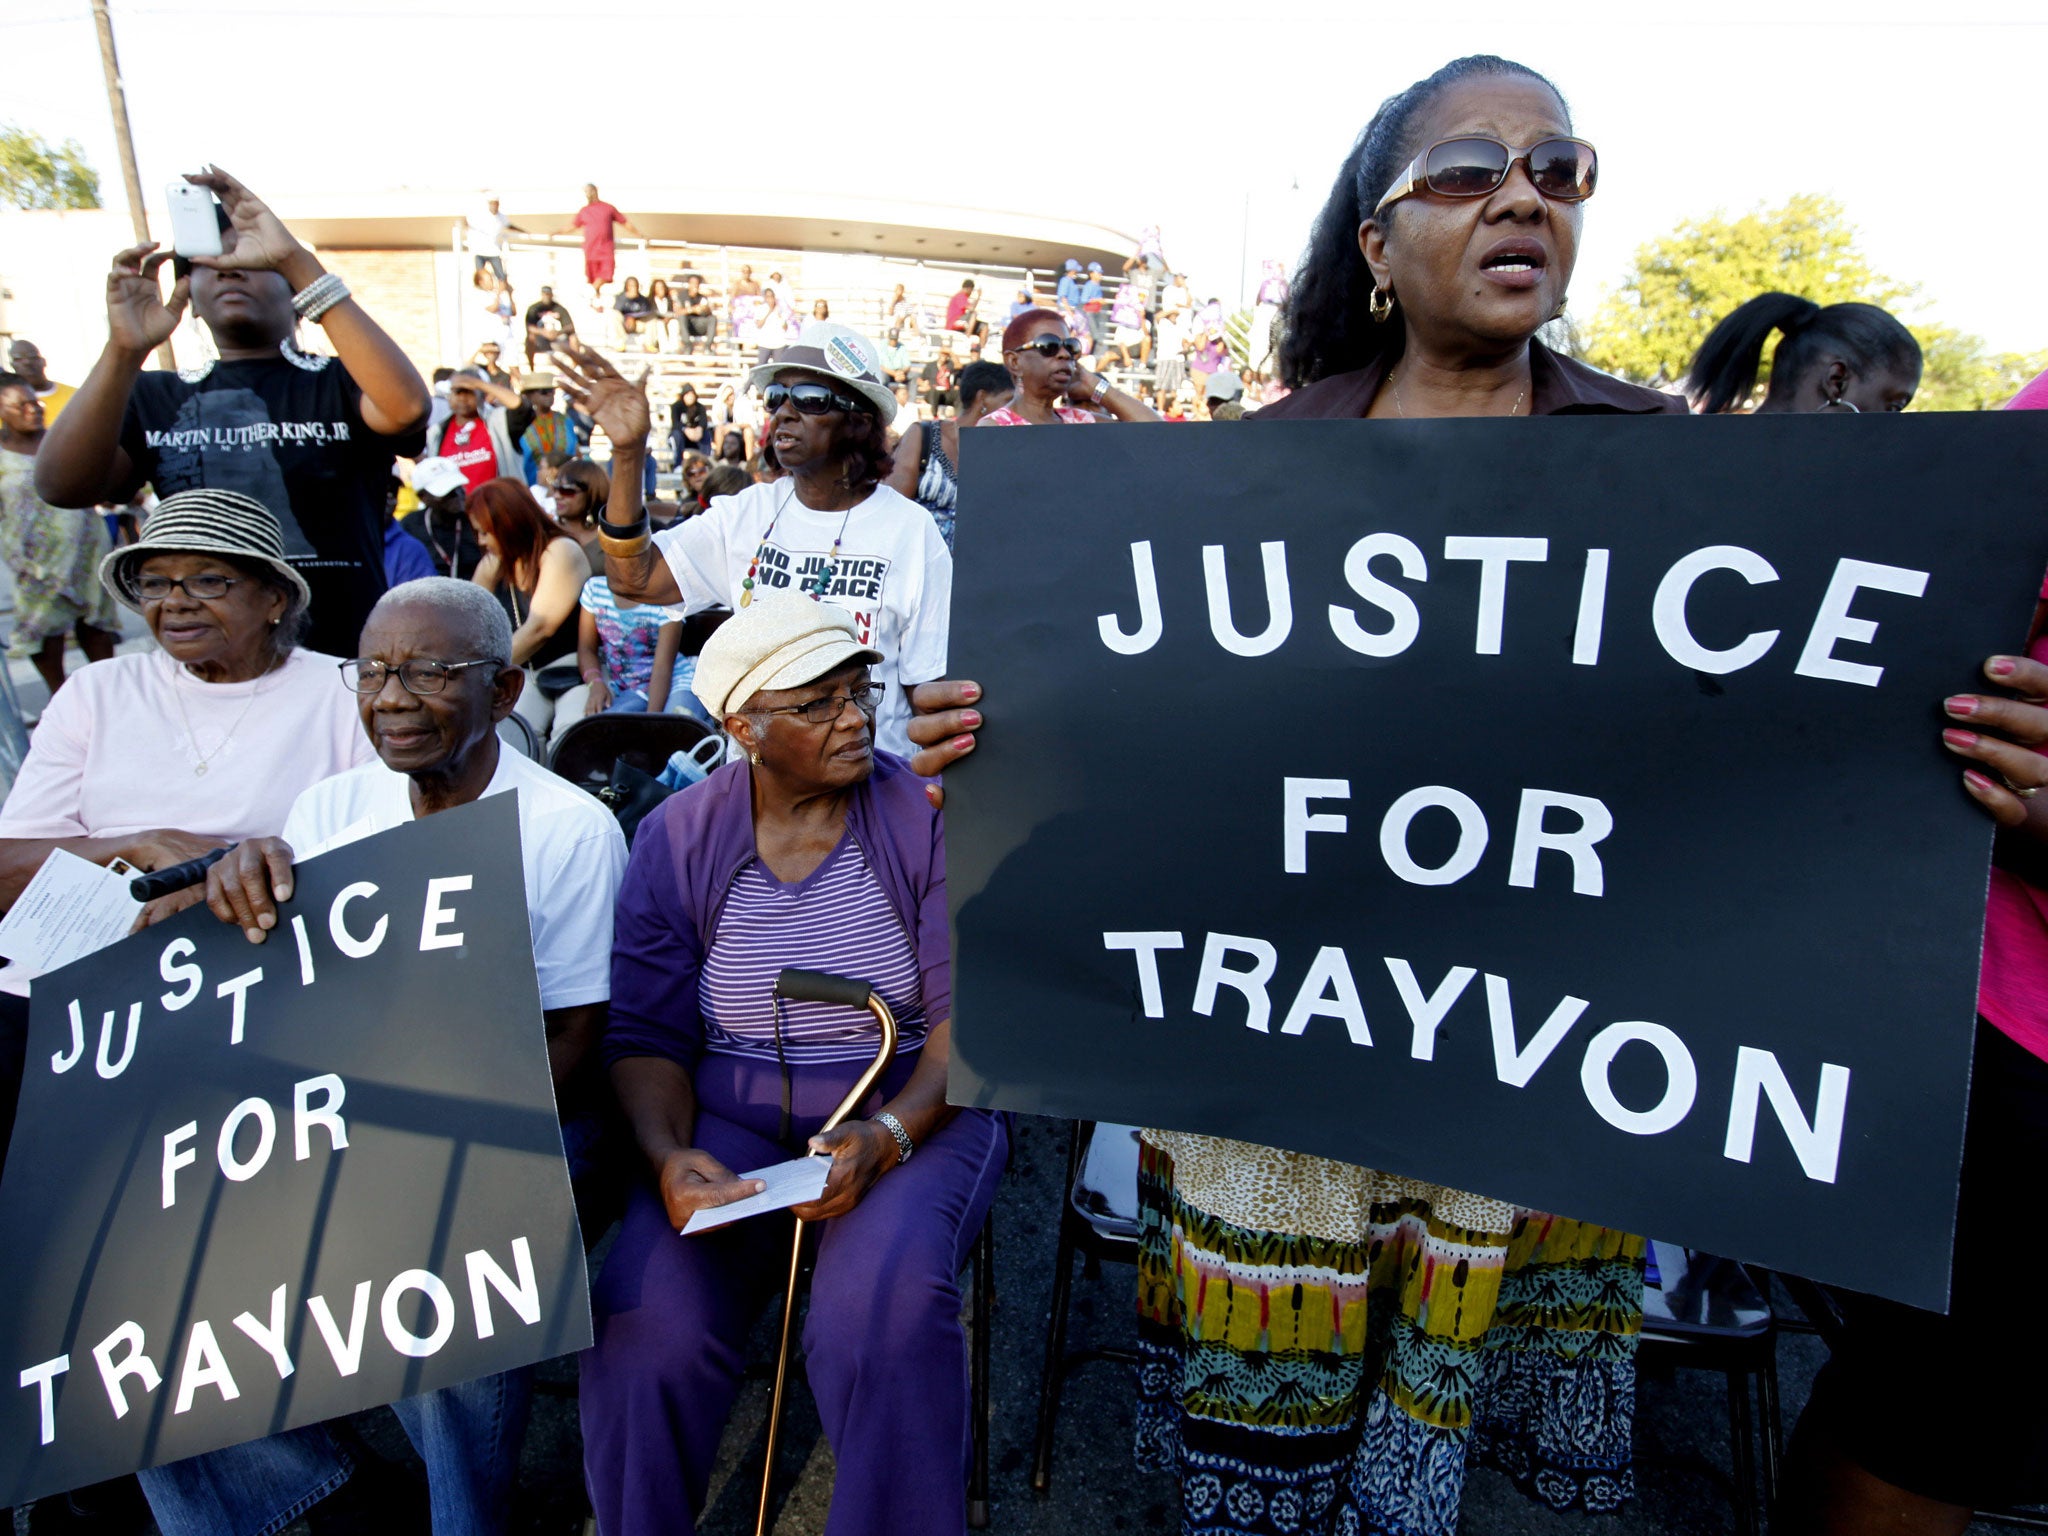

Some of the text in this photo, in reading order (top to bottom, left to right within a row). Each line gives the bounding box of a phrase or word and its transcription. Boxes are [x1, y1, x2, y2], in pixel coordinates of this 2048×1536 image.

[144, 421, 350, 449] MARTIN LUTHER KING, JR
[178, 439, 325, 453] MEMORIAL
[758, 565, 881, 601] NO PEACE
[760, 546, 886, 582] NO JUSTICE
[1098, 533, 1929, 687] JUSTICE
[1284, 777, 1613, 897] FOR
[51, 874, 474, 1080] JUSTICE
[1102, 931, 1851, 1184] TRAYVON
[160, 1073, 350, 1210] FOR
[20, 1236, 543, 1445] TRAYVON
